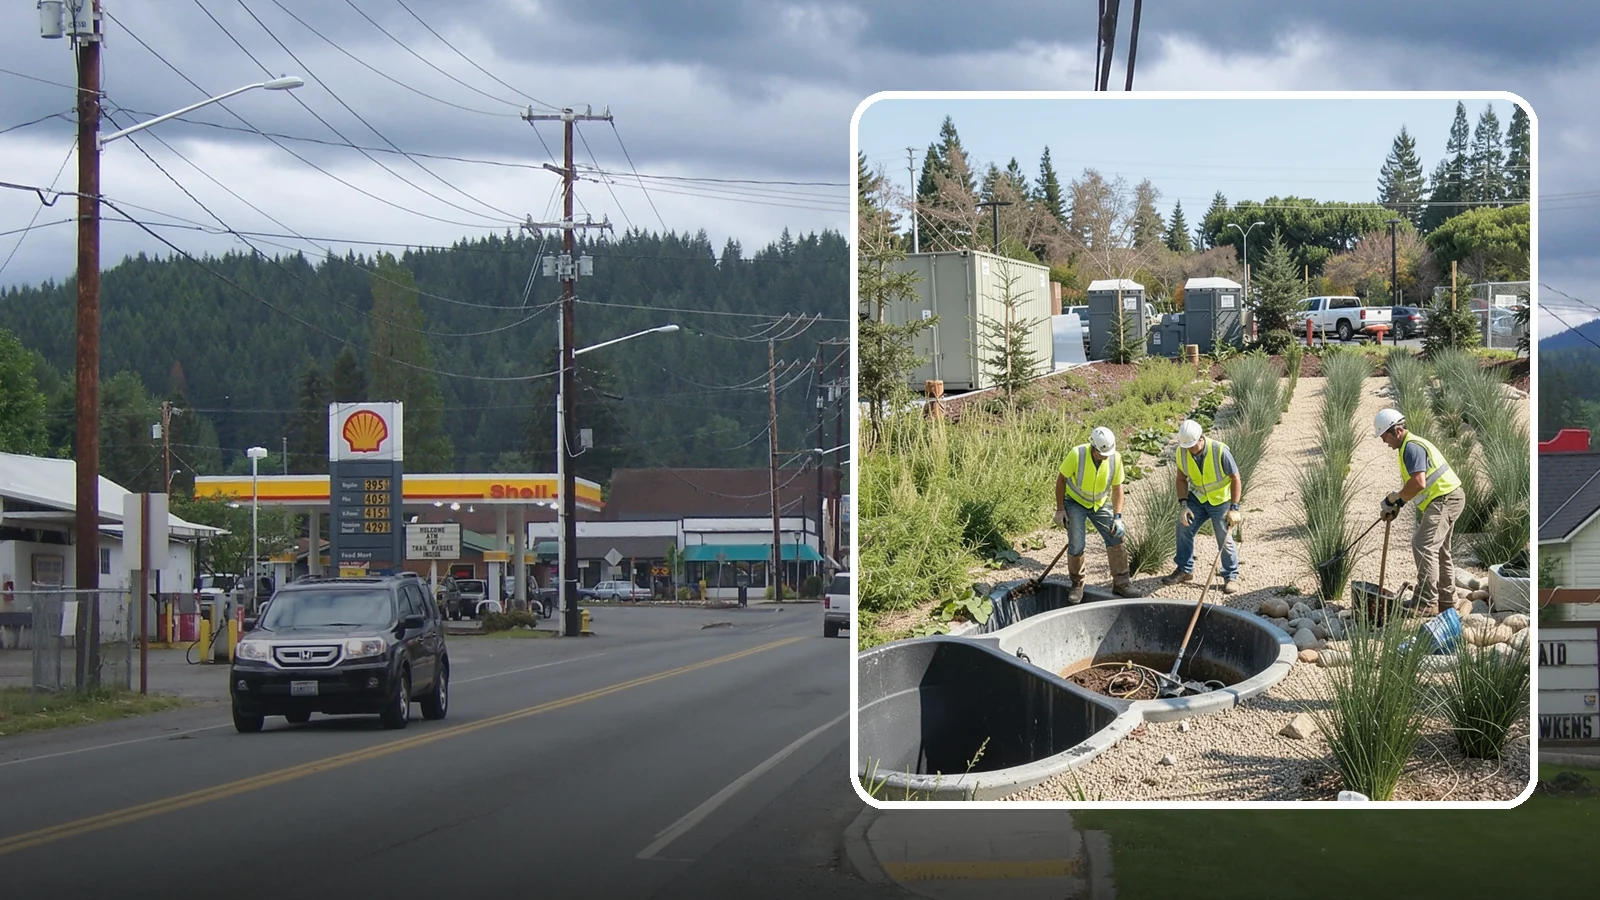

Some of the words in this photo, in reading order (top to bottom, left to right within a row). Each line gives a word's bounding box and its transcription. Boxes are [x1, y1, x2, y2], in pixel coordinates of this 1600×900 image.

[366, 480, 383, 490] 395
[490, 484, 547, 498] Shell
[366, 494, 383, 504] 405
[366, 508, 383, 518] 415
[366, 522, 383, 532] 429
[1538, 642, 1566, 666] AID
